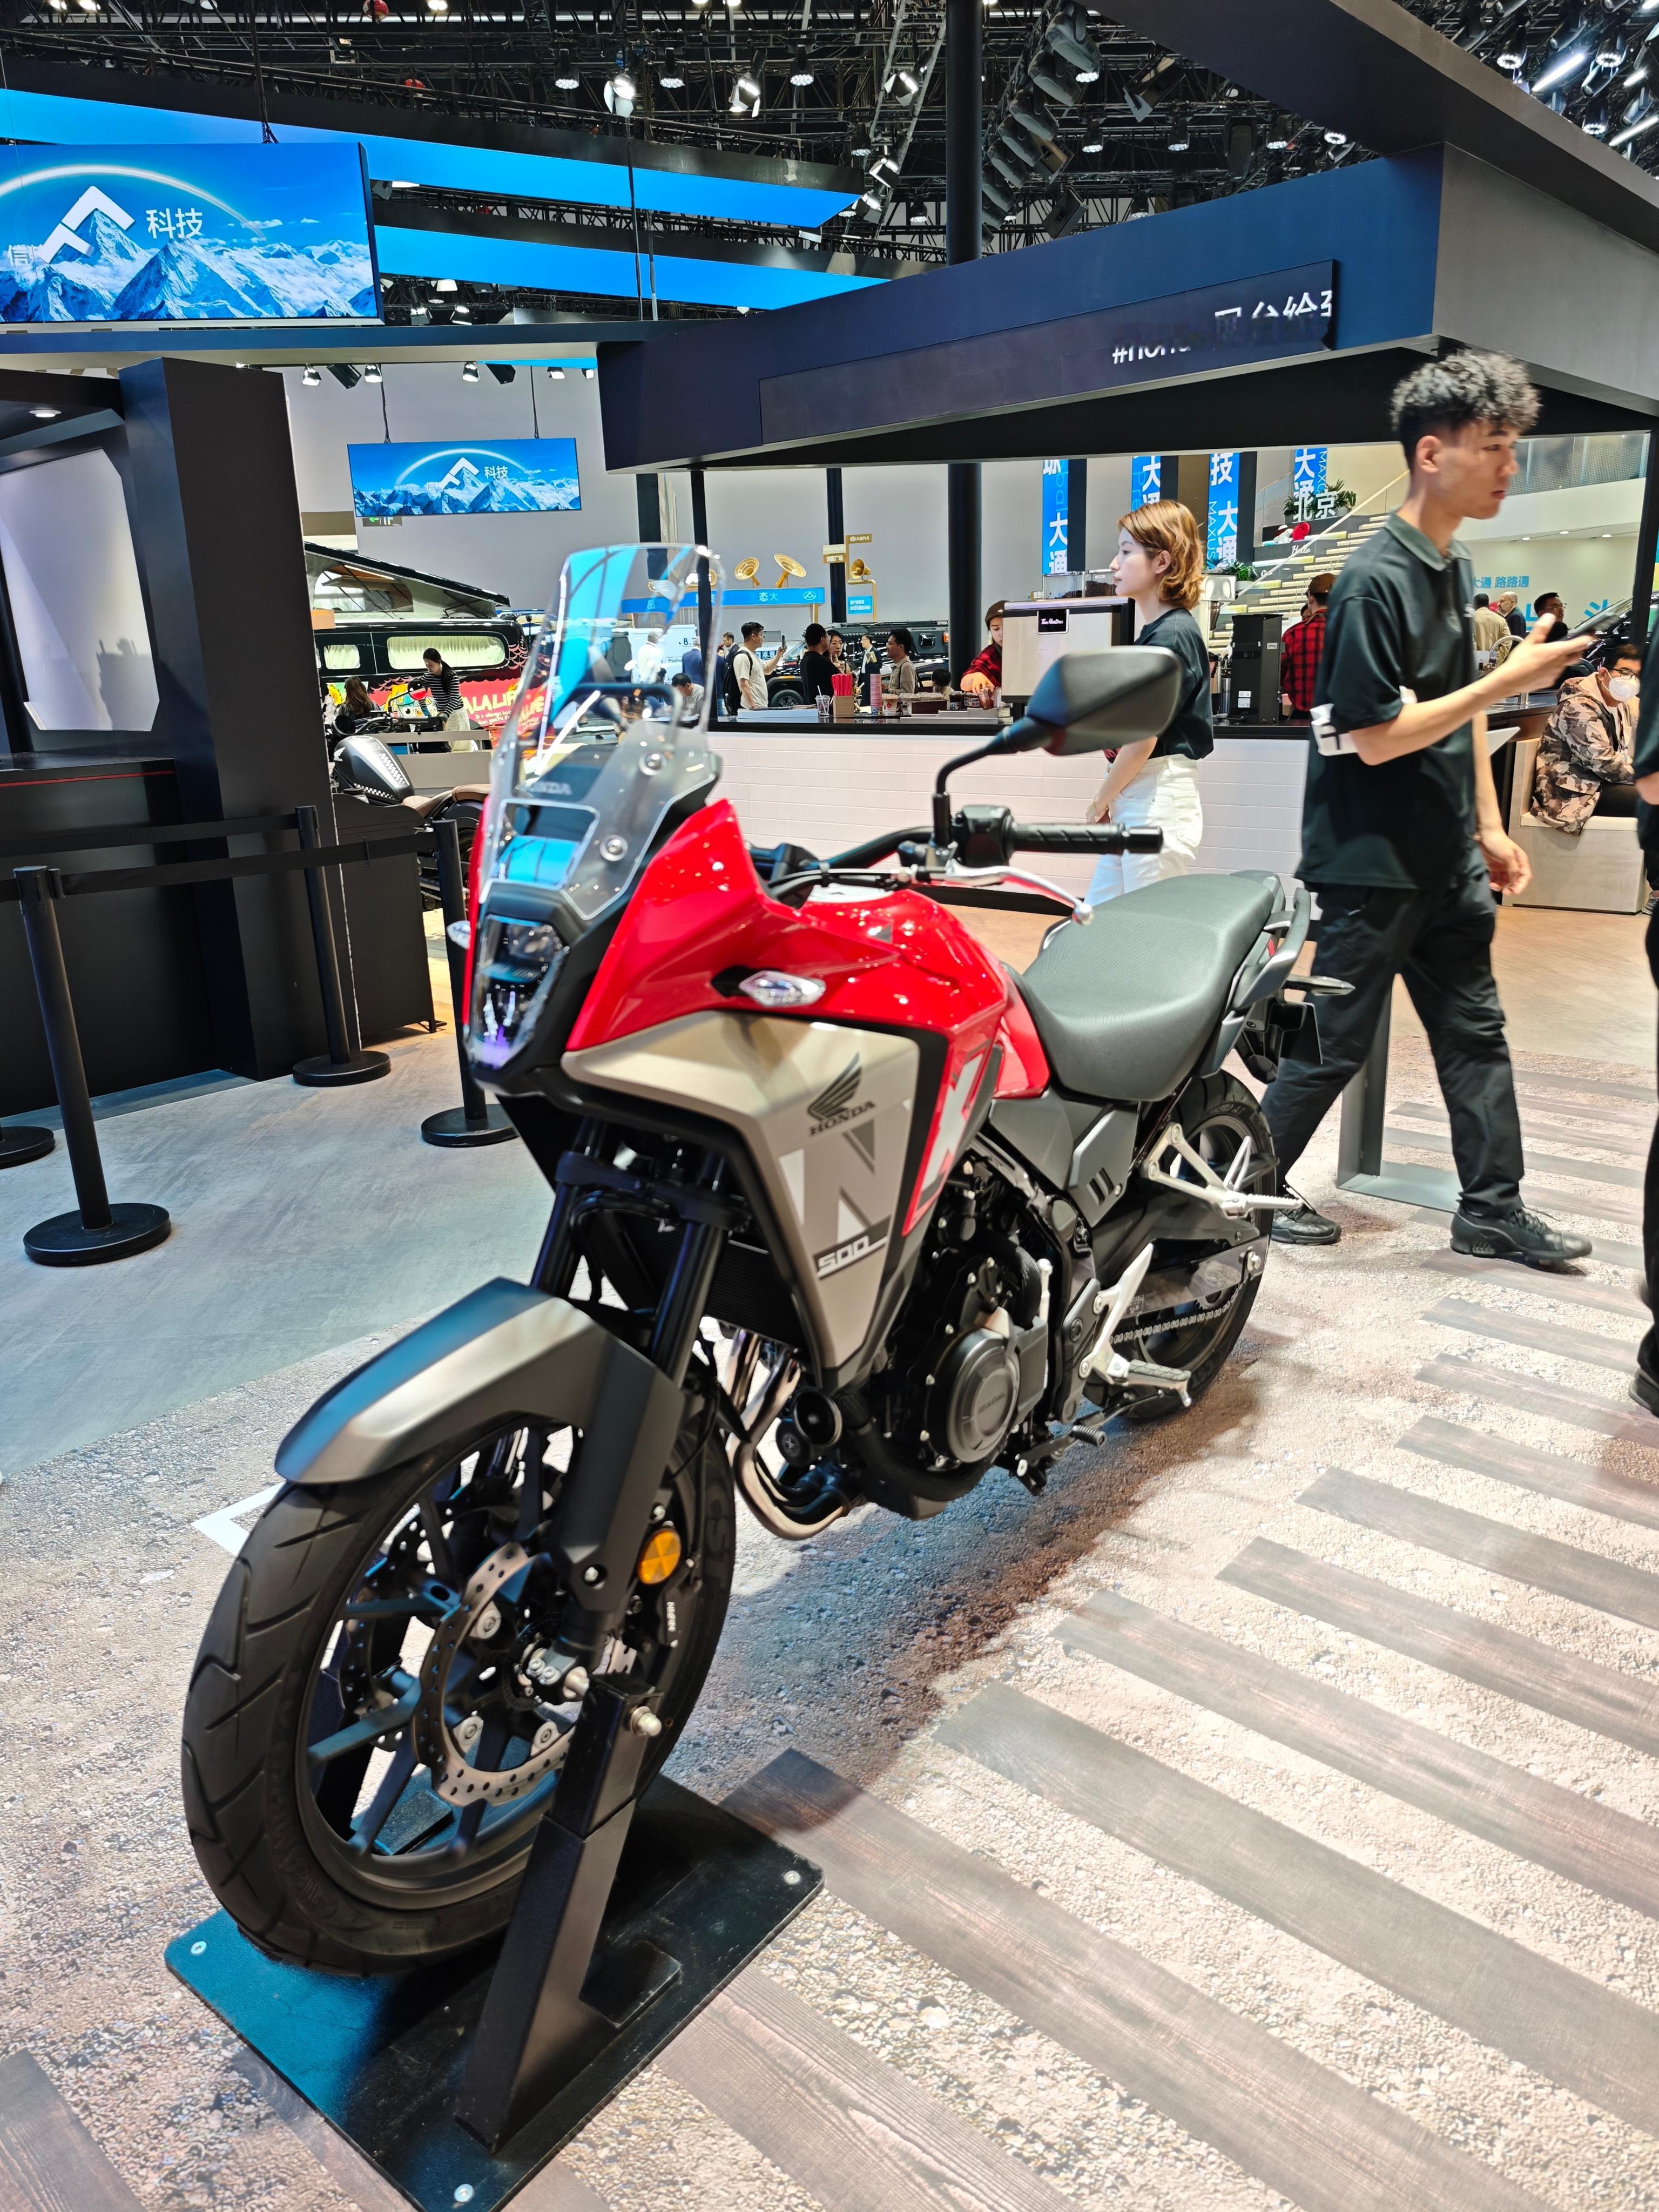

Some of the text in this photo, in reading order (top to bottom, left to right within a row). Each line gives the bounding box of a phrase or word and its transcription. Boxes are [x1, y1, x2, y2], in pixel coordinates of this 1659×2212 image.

[145, 208, 203, 239] 科技
[484, 466, 508, 479] 科技
[1317, 450, 1327, 494] MAXU
[1292, 489, 1338, 522] 北京
[1207, 501, 1218, 562] MAXUS
[1494, 576, 1529, 588] 路路通
[810, 1100, 876, 1136] HONDA
[818, 1235, 871, 1273] 500
